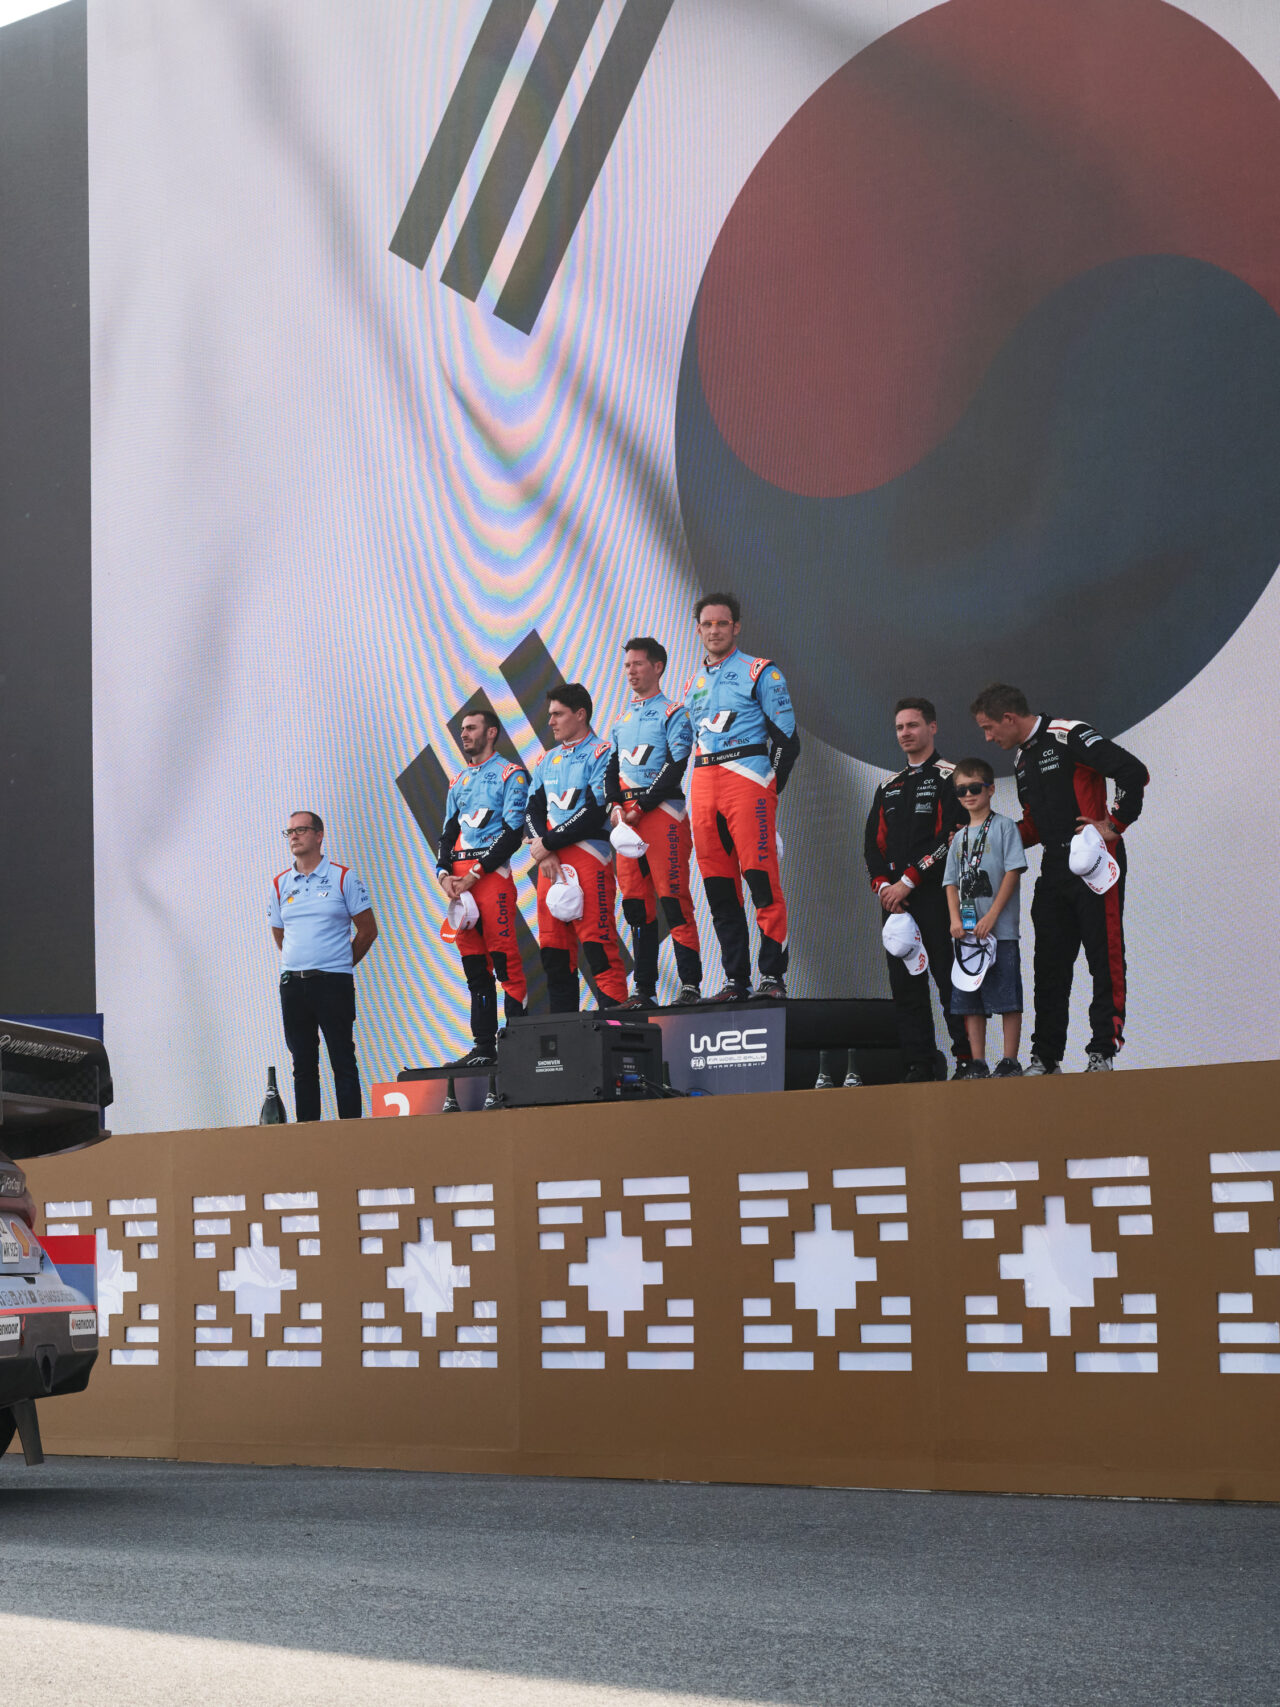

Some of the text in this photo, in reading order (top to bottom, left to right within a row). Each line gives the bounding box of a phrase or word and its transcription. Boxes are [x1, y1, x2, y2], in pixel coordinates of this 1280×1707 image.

[667, 824, 680, 894] M.Wydaeghe
[755, 798, 768, 862] T.Neuville
[496, 893, 510, 938] A.Coria
[597, 870, 610, 940] A.Fourmaux
[690, 1028, 768, 1053] WRC
